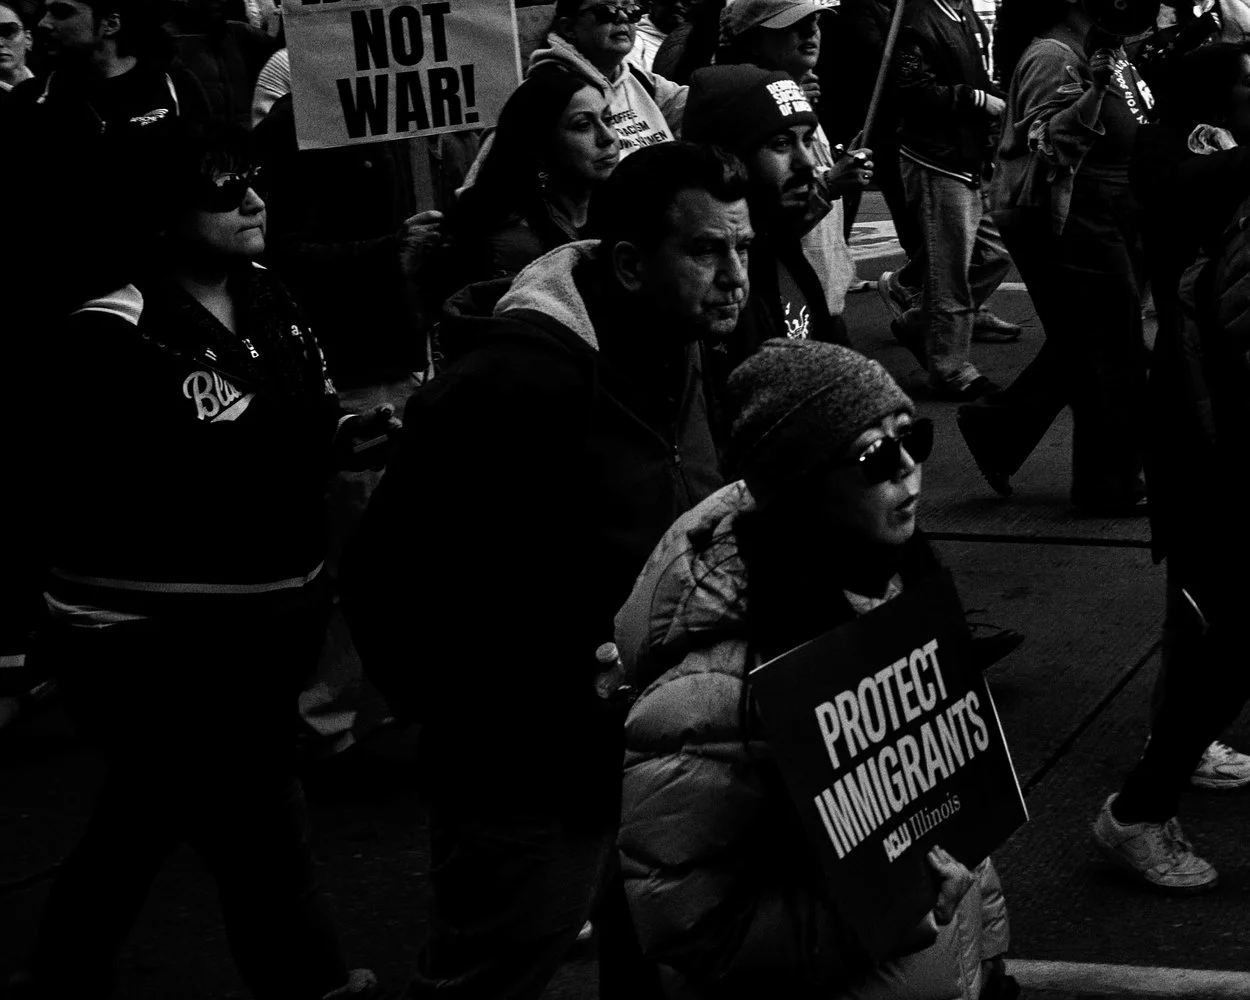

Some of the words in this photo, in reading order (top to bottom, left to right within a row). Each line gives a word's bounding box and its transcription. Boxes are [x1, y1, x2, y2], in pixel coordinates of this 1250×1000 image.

[350, 1, 451, 71] NOT
[336, 63, 480, 139] WAR!
[814, 637, 948, 770] PROTECT
[814, 689, 990, 861] IMMIGRANTS
[882, 822, 913, 865] ACLU
[908, 791, 962, 841] Illinois
